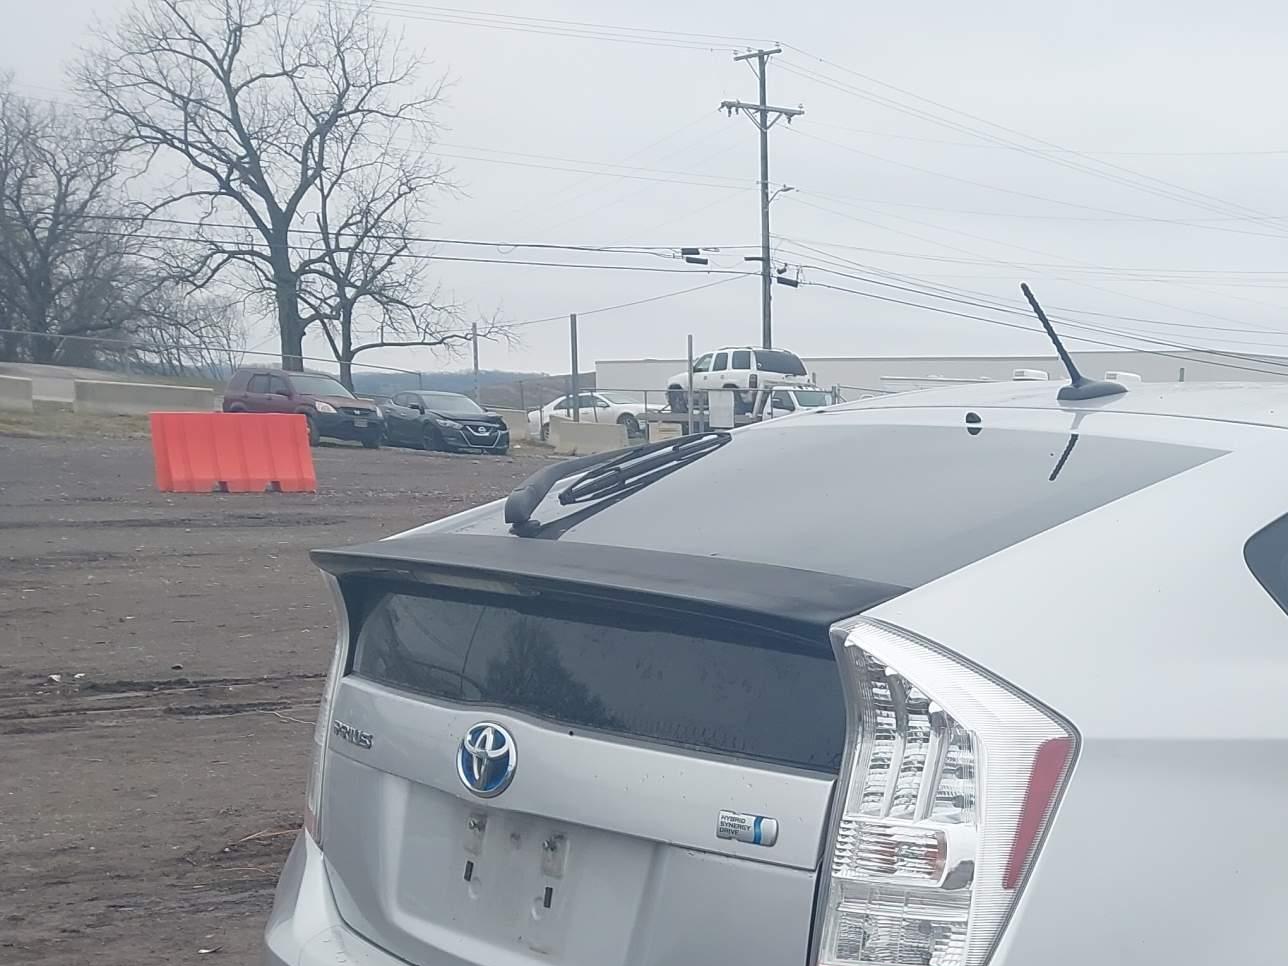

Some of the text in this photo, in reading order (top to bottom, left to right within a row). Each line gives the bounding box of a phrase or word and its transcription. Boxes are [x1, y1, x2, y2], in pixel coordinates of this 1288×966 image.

[720, 815, 746, 824] HYBRID
[719, 820, 752, 832] SYNERGY
[719, 827, 739, 836] DRIVE
